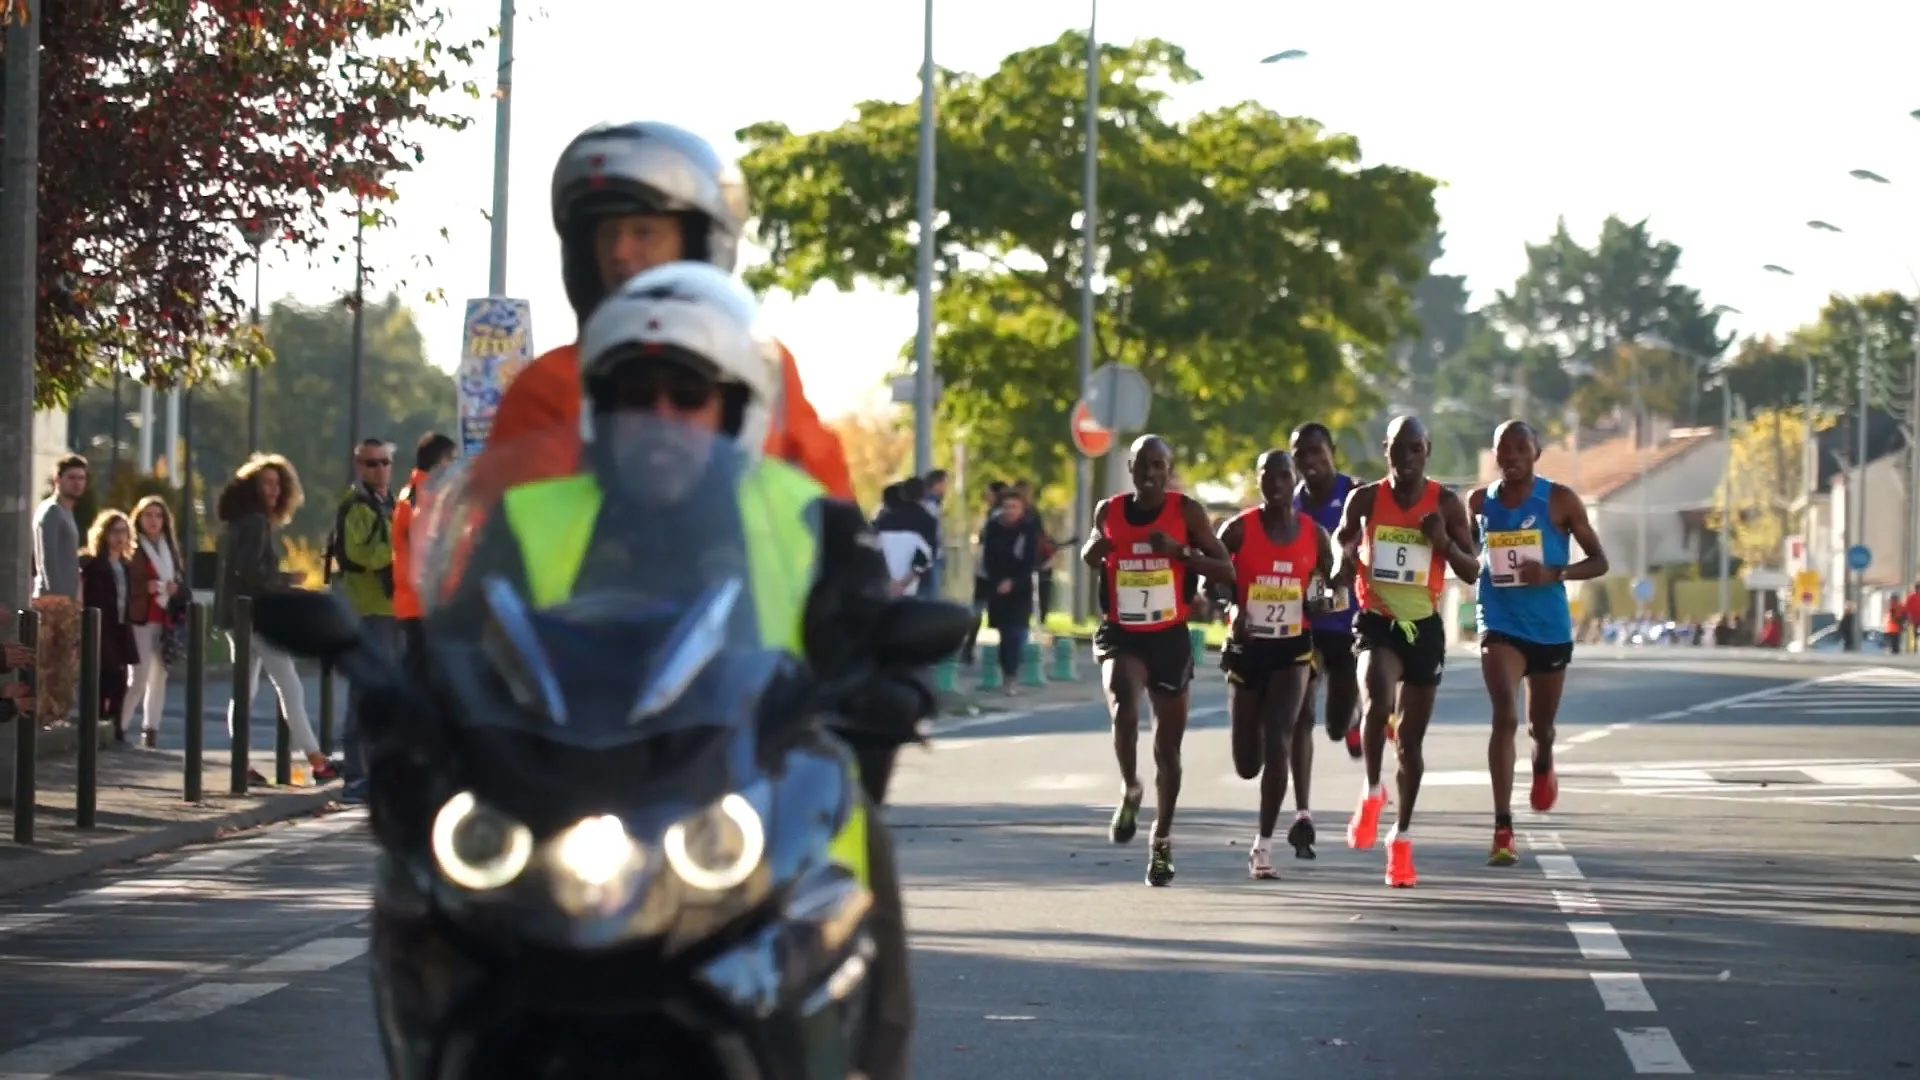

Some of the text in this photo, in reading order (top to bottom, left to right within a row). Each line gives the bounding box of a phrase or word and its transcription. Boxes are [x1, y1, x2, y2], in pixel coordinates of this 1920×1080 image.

[1396, 546, 1407, 567] 6
[1507, 549, 1517, 569] 9
[1140, 590, 1149, 608] 7
[1265, 604, 1286, 623] 22
